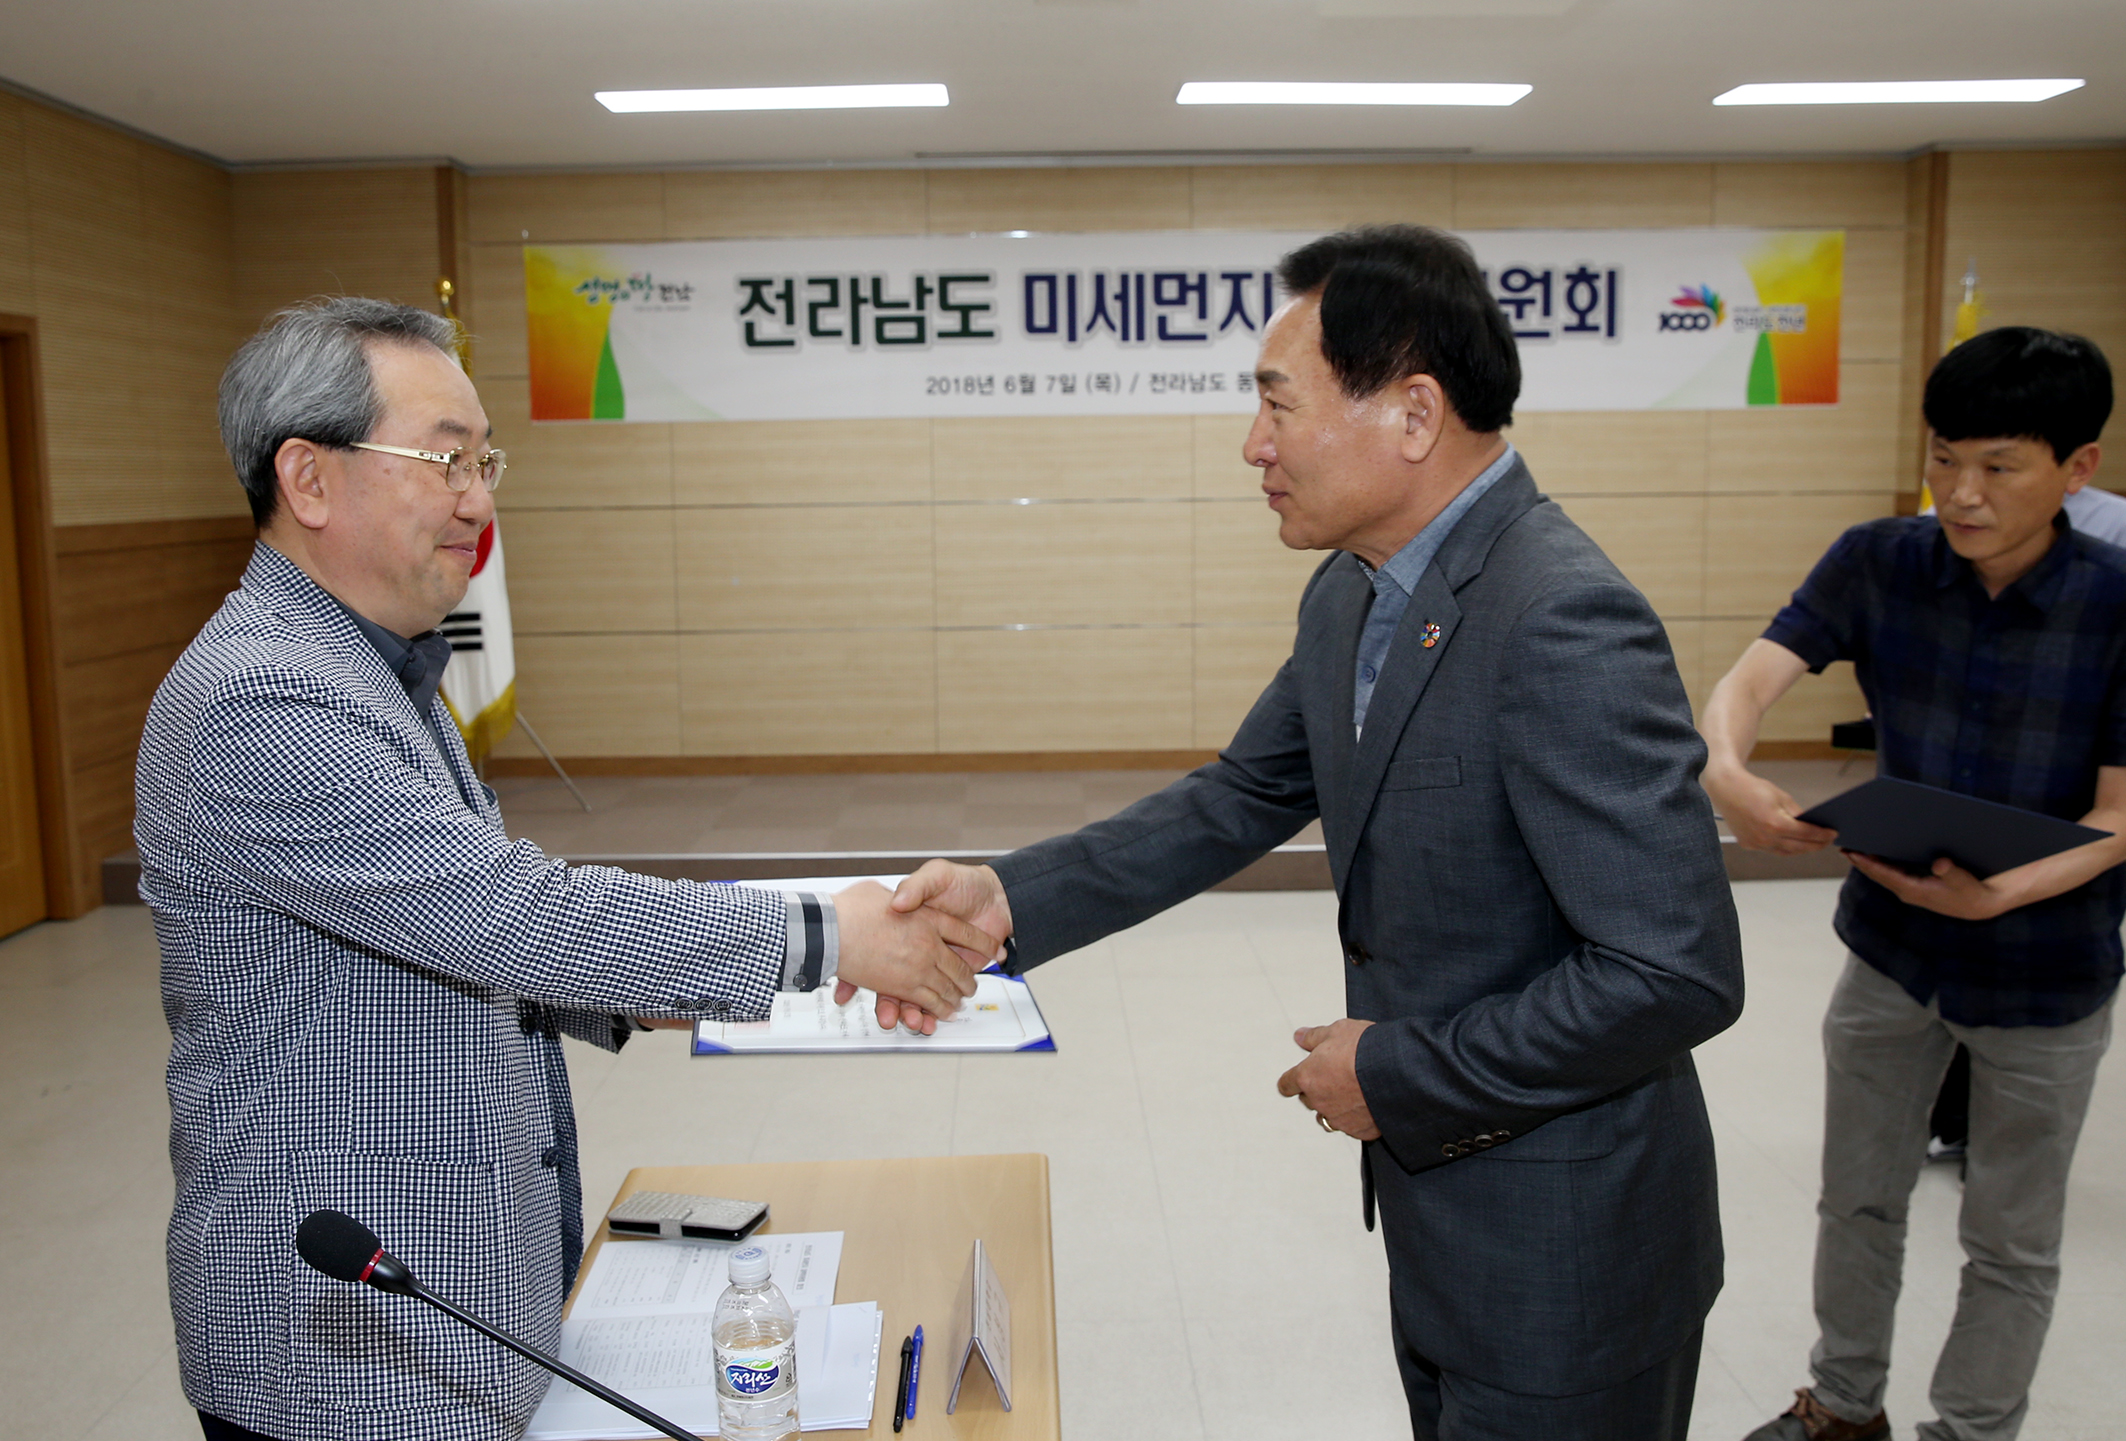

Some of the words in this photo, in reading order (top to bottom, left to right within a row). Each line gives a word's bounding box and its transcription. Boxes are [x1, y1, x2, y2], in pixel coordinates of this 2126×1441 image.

[740, 274, 994, 347] 전라남도
[1024, 271, 1273, 342] 미세먼지
[1479, 266, 1616, 338] 원회
[926, 375, 994, 396] 2018년
[1004, 373, 1036, 395] 6월
[1046, 373, 1076, 395] 7일
[1085, 372, 1121, 395] (목)
[1149, 372, 1227, 394] 전라남도
[1237, 371, 1254, 394] 동
[730, 1371, 778, 1388] 지리산
